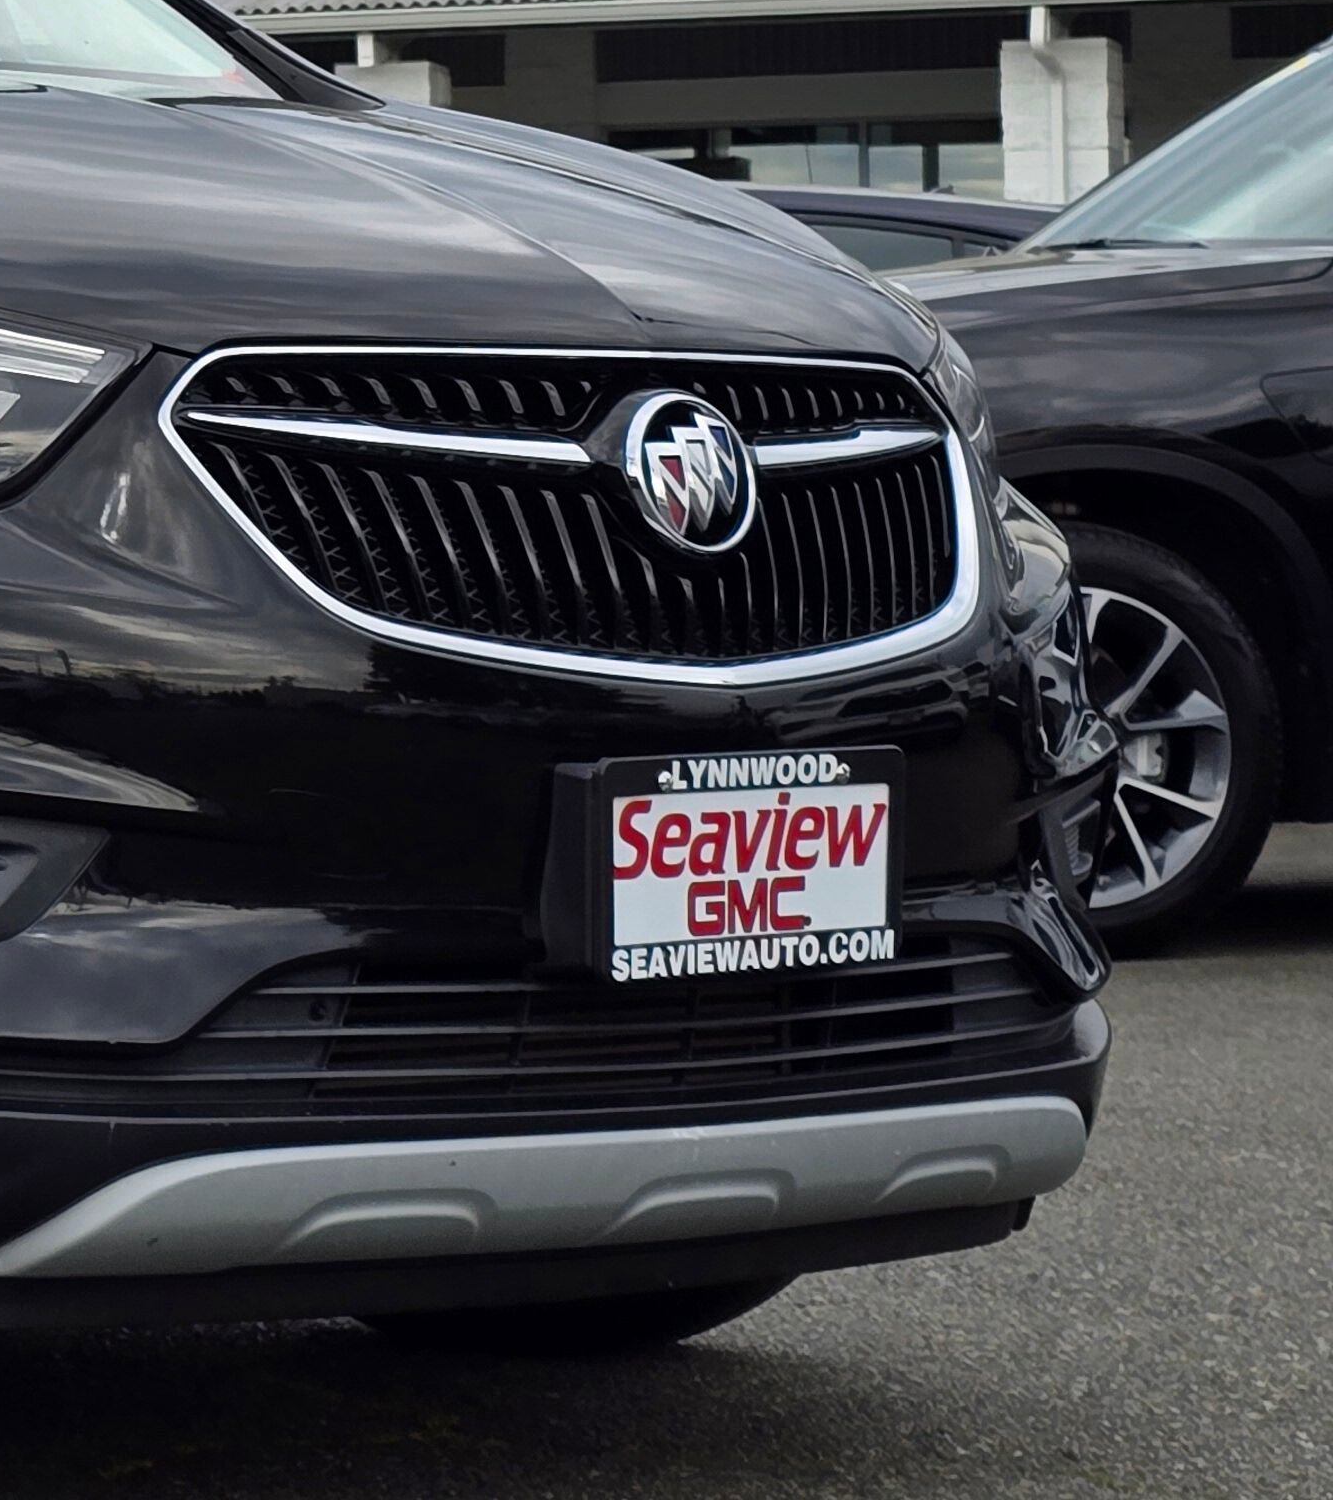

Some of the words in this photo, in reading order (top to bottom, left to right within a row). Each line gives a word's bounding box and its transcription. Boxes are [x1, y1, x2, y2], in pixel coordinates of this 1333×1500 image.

[672, 754, 839, 790] LYNNWOOD
[613, 792, 887, 880] Seaview
[687, 875, 806, 937] GMC
[611, 929, 895, 982] SEAVIEWAUTO.COM
